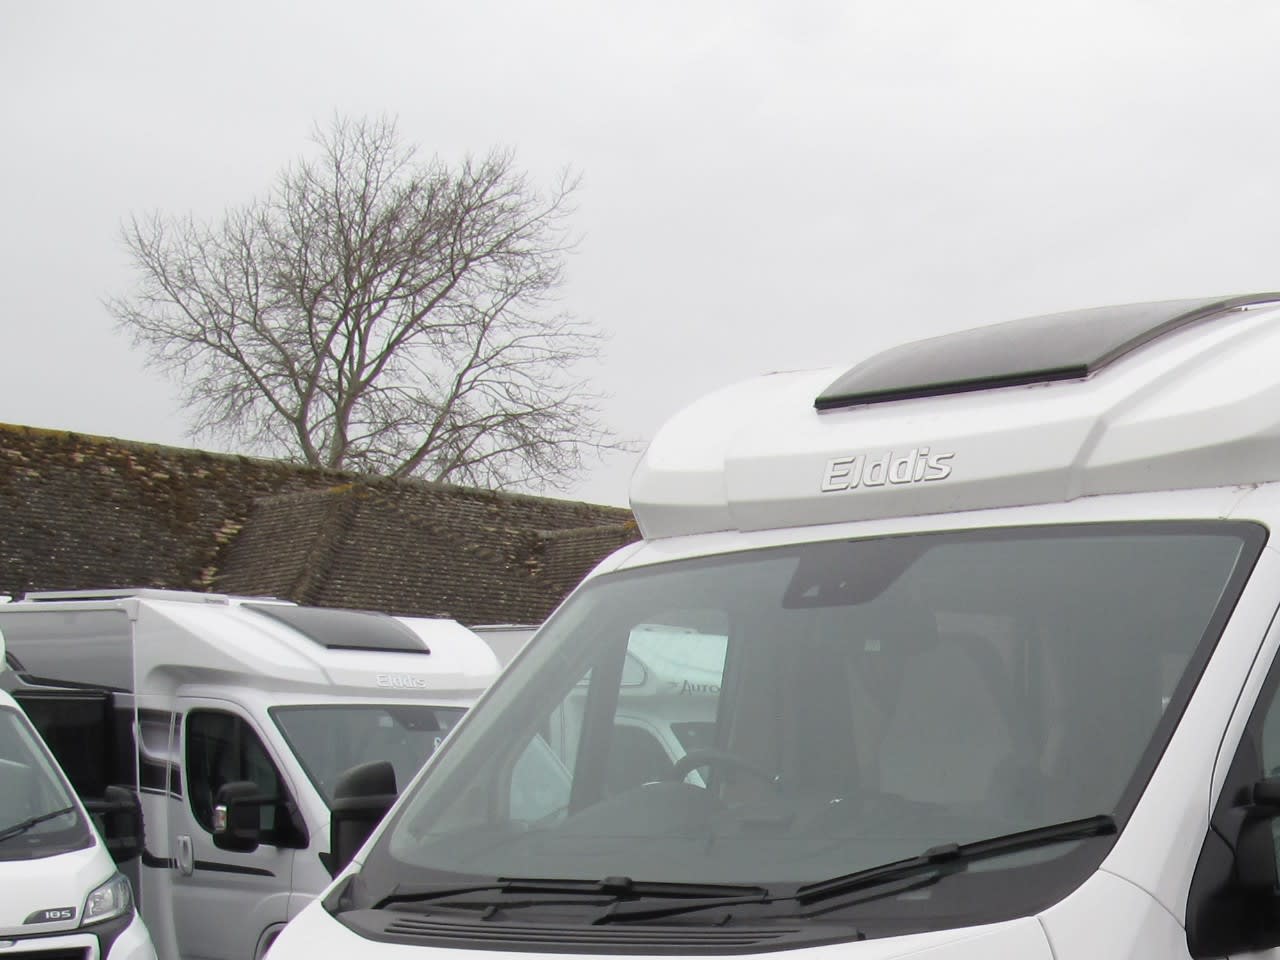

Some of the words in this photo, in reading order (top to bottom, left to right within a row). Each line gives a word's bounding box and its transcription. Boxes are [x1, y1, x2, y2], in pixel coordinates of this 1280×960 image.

[821, 447, 955, 492] Elddis
[376, 673, 426, 688] Elddis
[45, 910, 72, 919] 185
